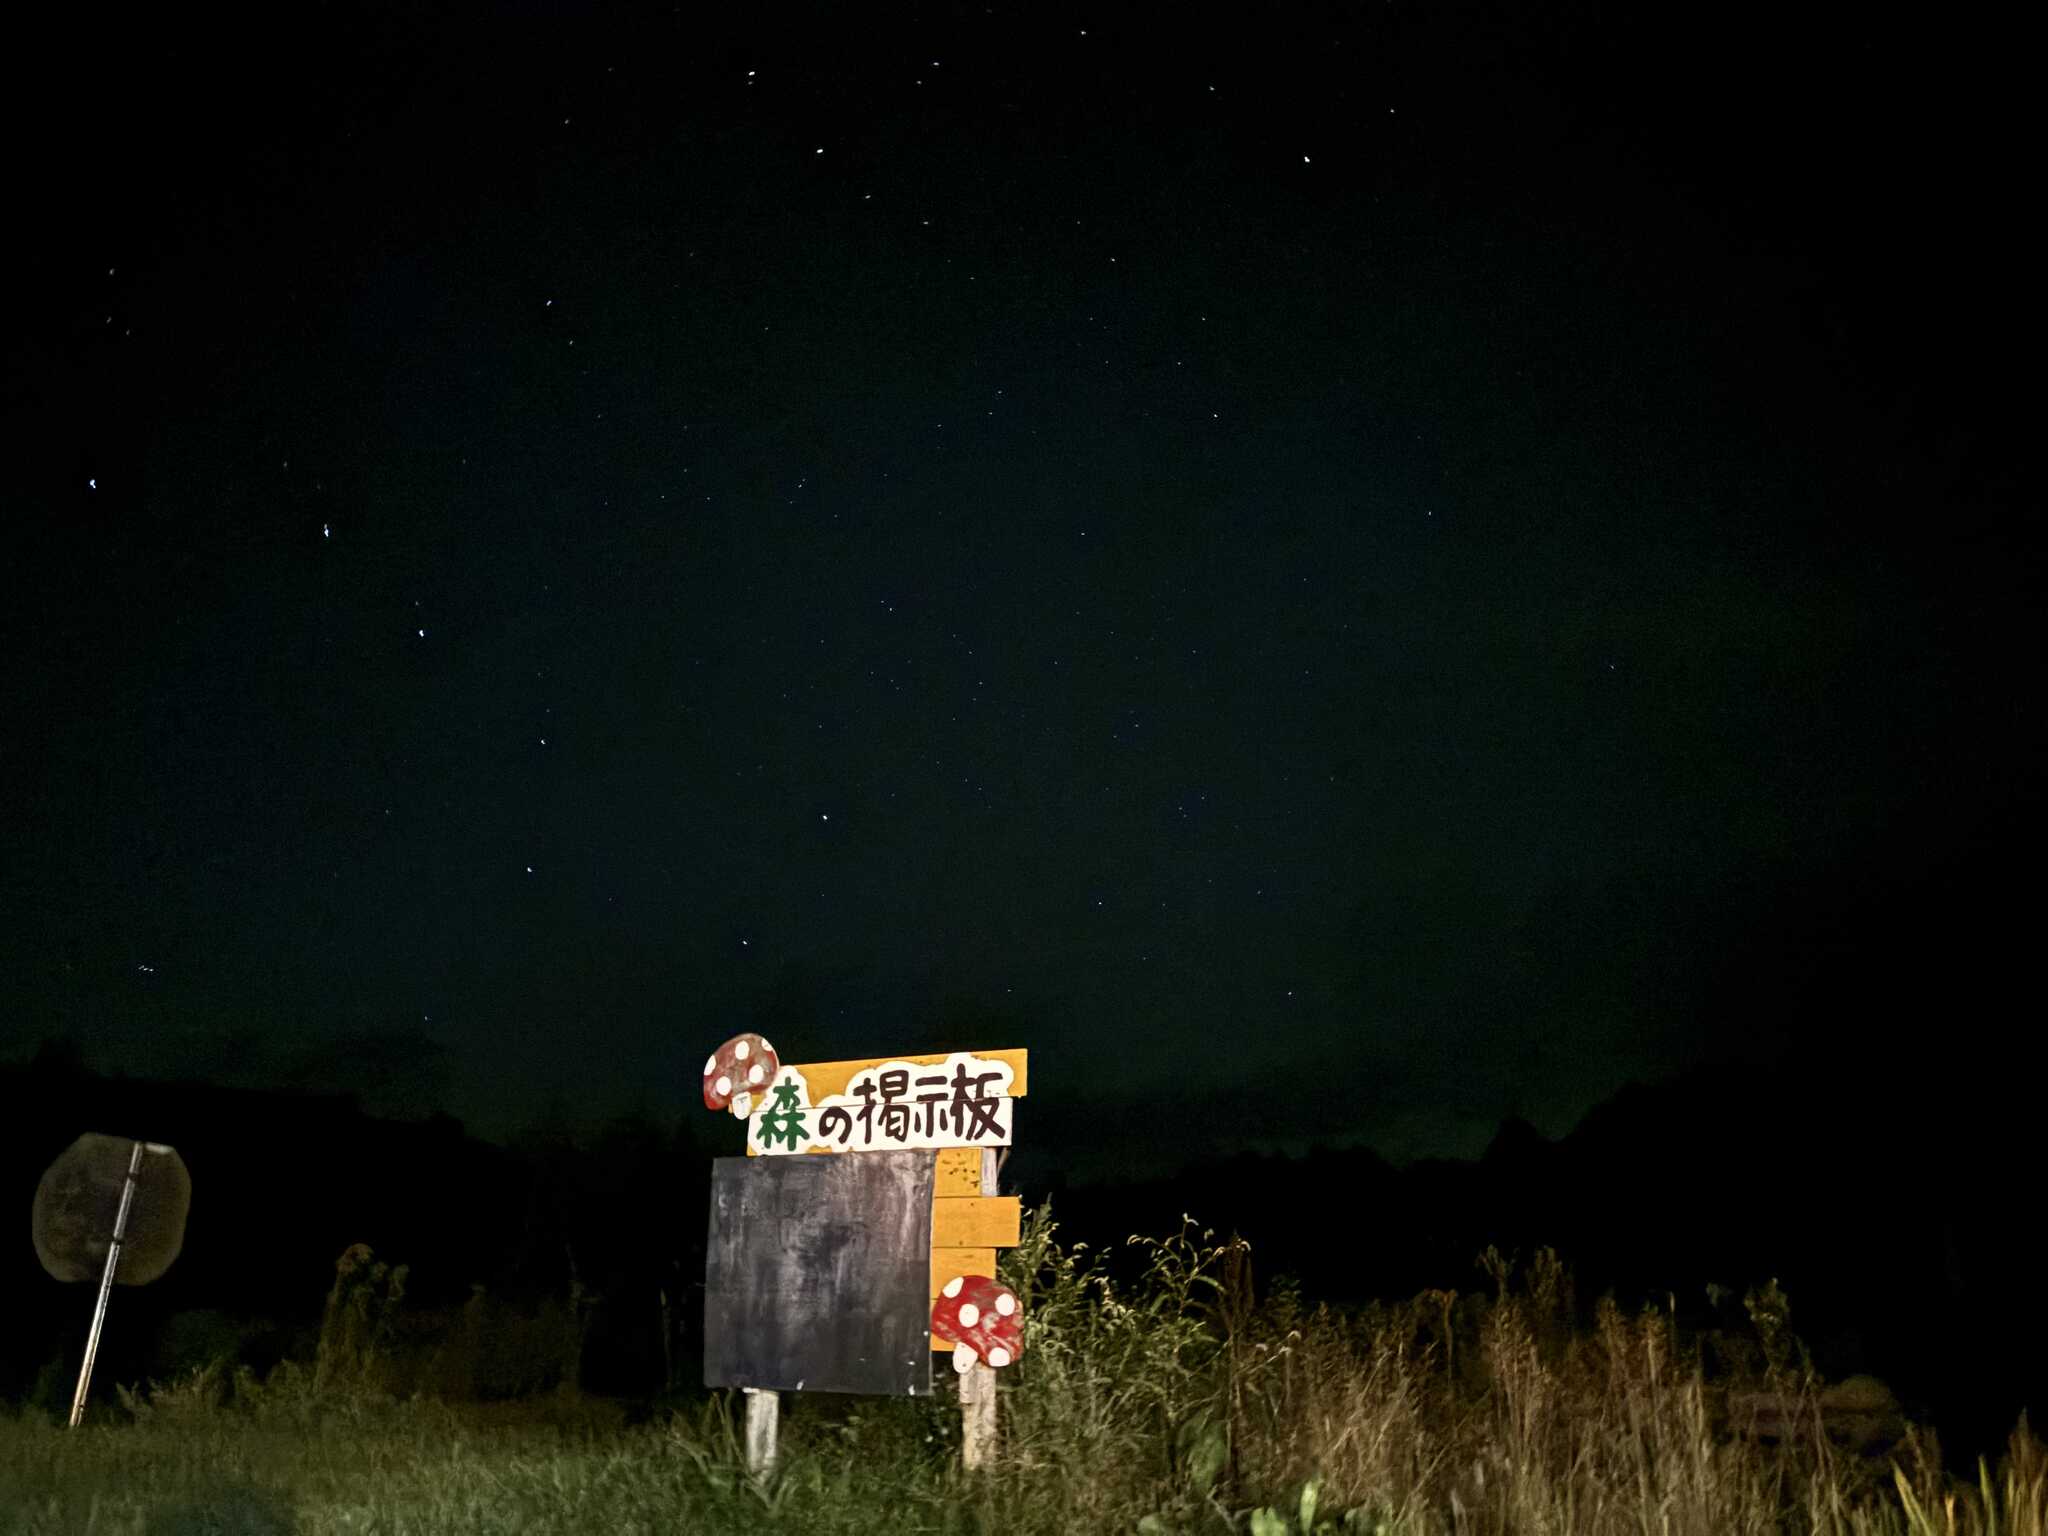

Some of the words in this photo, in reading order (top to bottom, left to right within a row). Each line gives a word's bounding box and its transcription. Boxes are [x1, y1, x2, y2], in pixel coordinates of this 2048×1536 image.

[757, 1064, 1006, 1150] 森の掲示板
